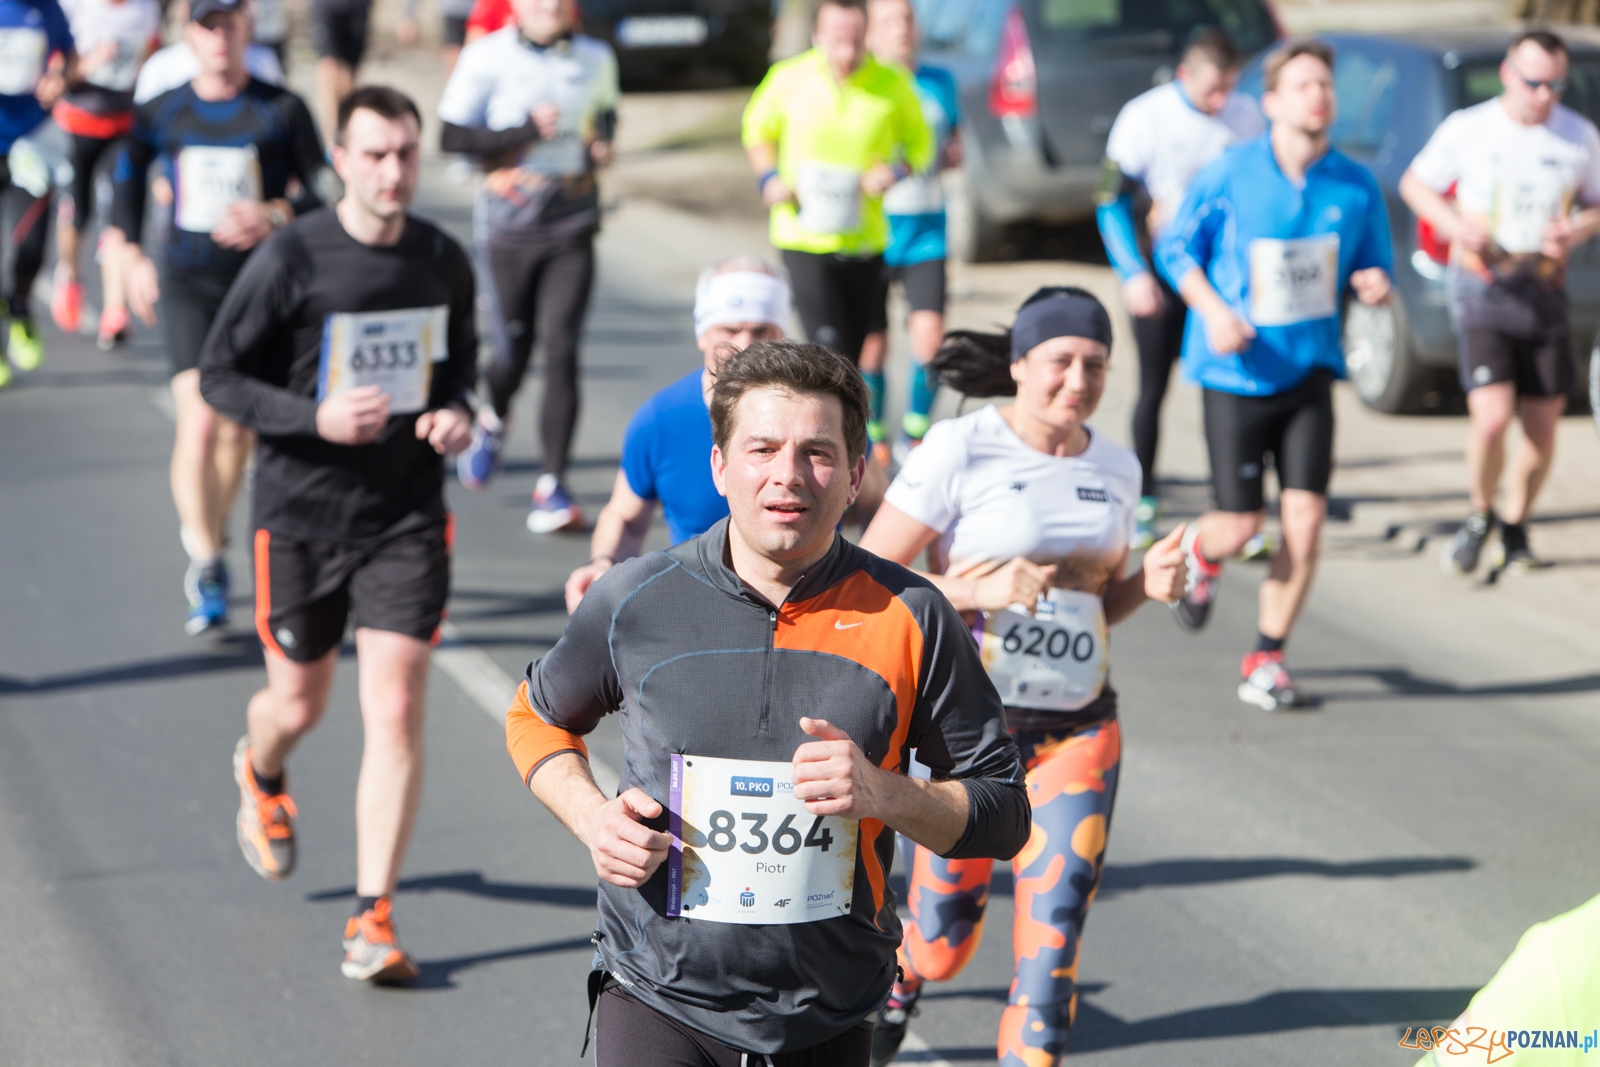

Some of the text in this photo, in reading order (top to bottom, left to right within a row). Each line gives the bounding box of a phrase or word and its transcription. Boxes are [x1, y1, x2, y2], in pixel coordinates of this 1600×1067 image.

[350, 342, 417, 372] 6333
[1003, 623, 1094, 662] 6200
[749, 782, 770, 792] PKO
[707, 809, 833, 855] 8364
[756, 862, 787, 874] Piotr
